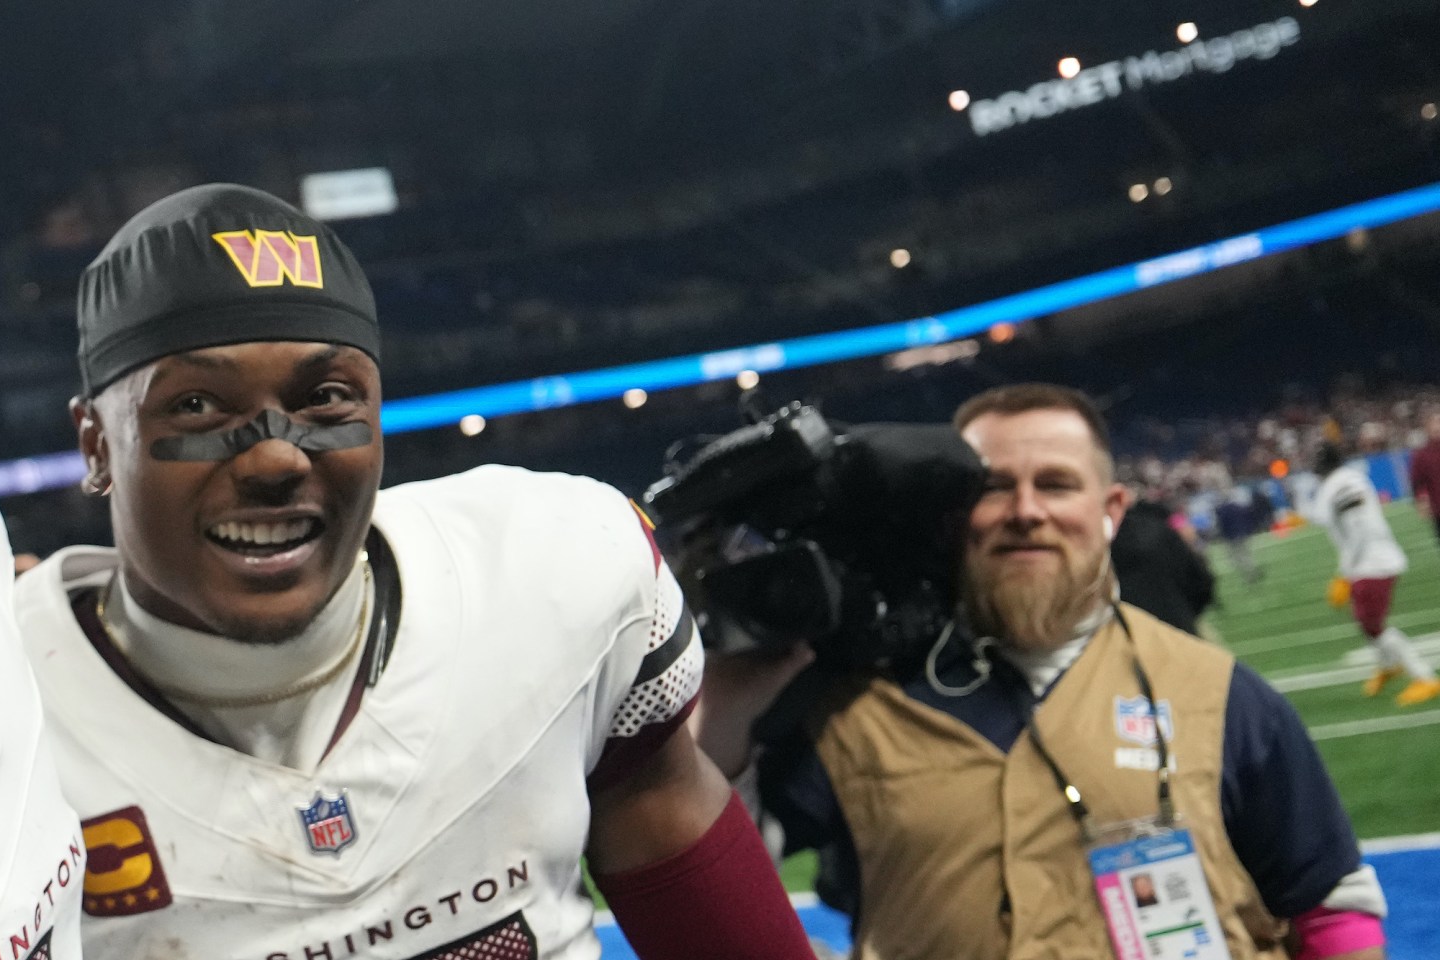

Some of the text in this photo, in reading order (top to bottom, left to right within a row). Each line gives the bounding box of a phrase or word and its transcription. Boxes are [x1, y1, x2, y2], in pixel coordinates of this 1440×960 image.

[969, 16, 1301, 136] ROCKET Mortgage
[311, 817, 350, 846] NFL
